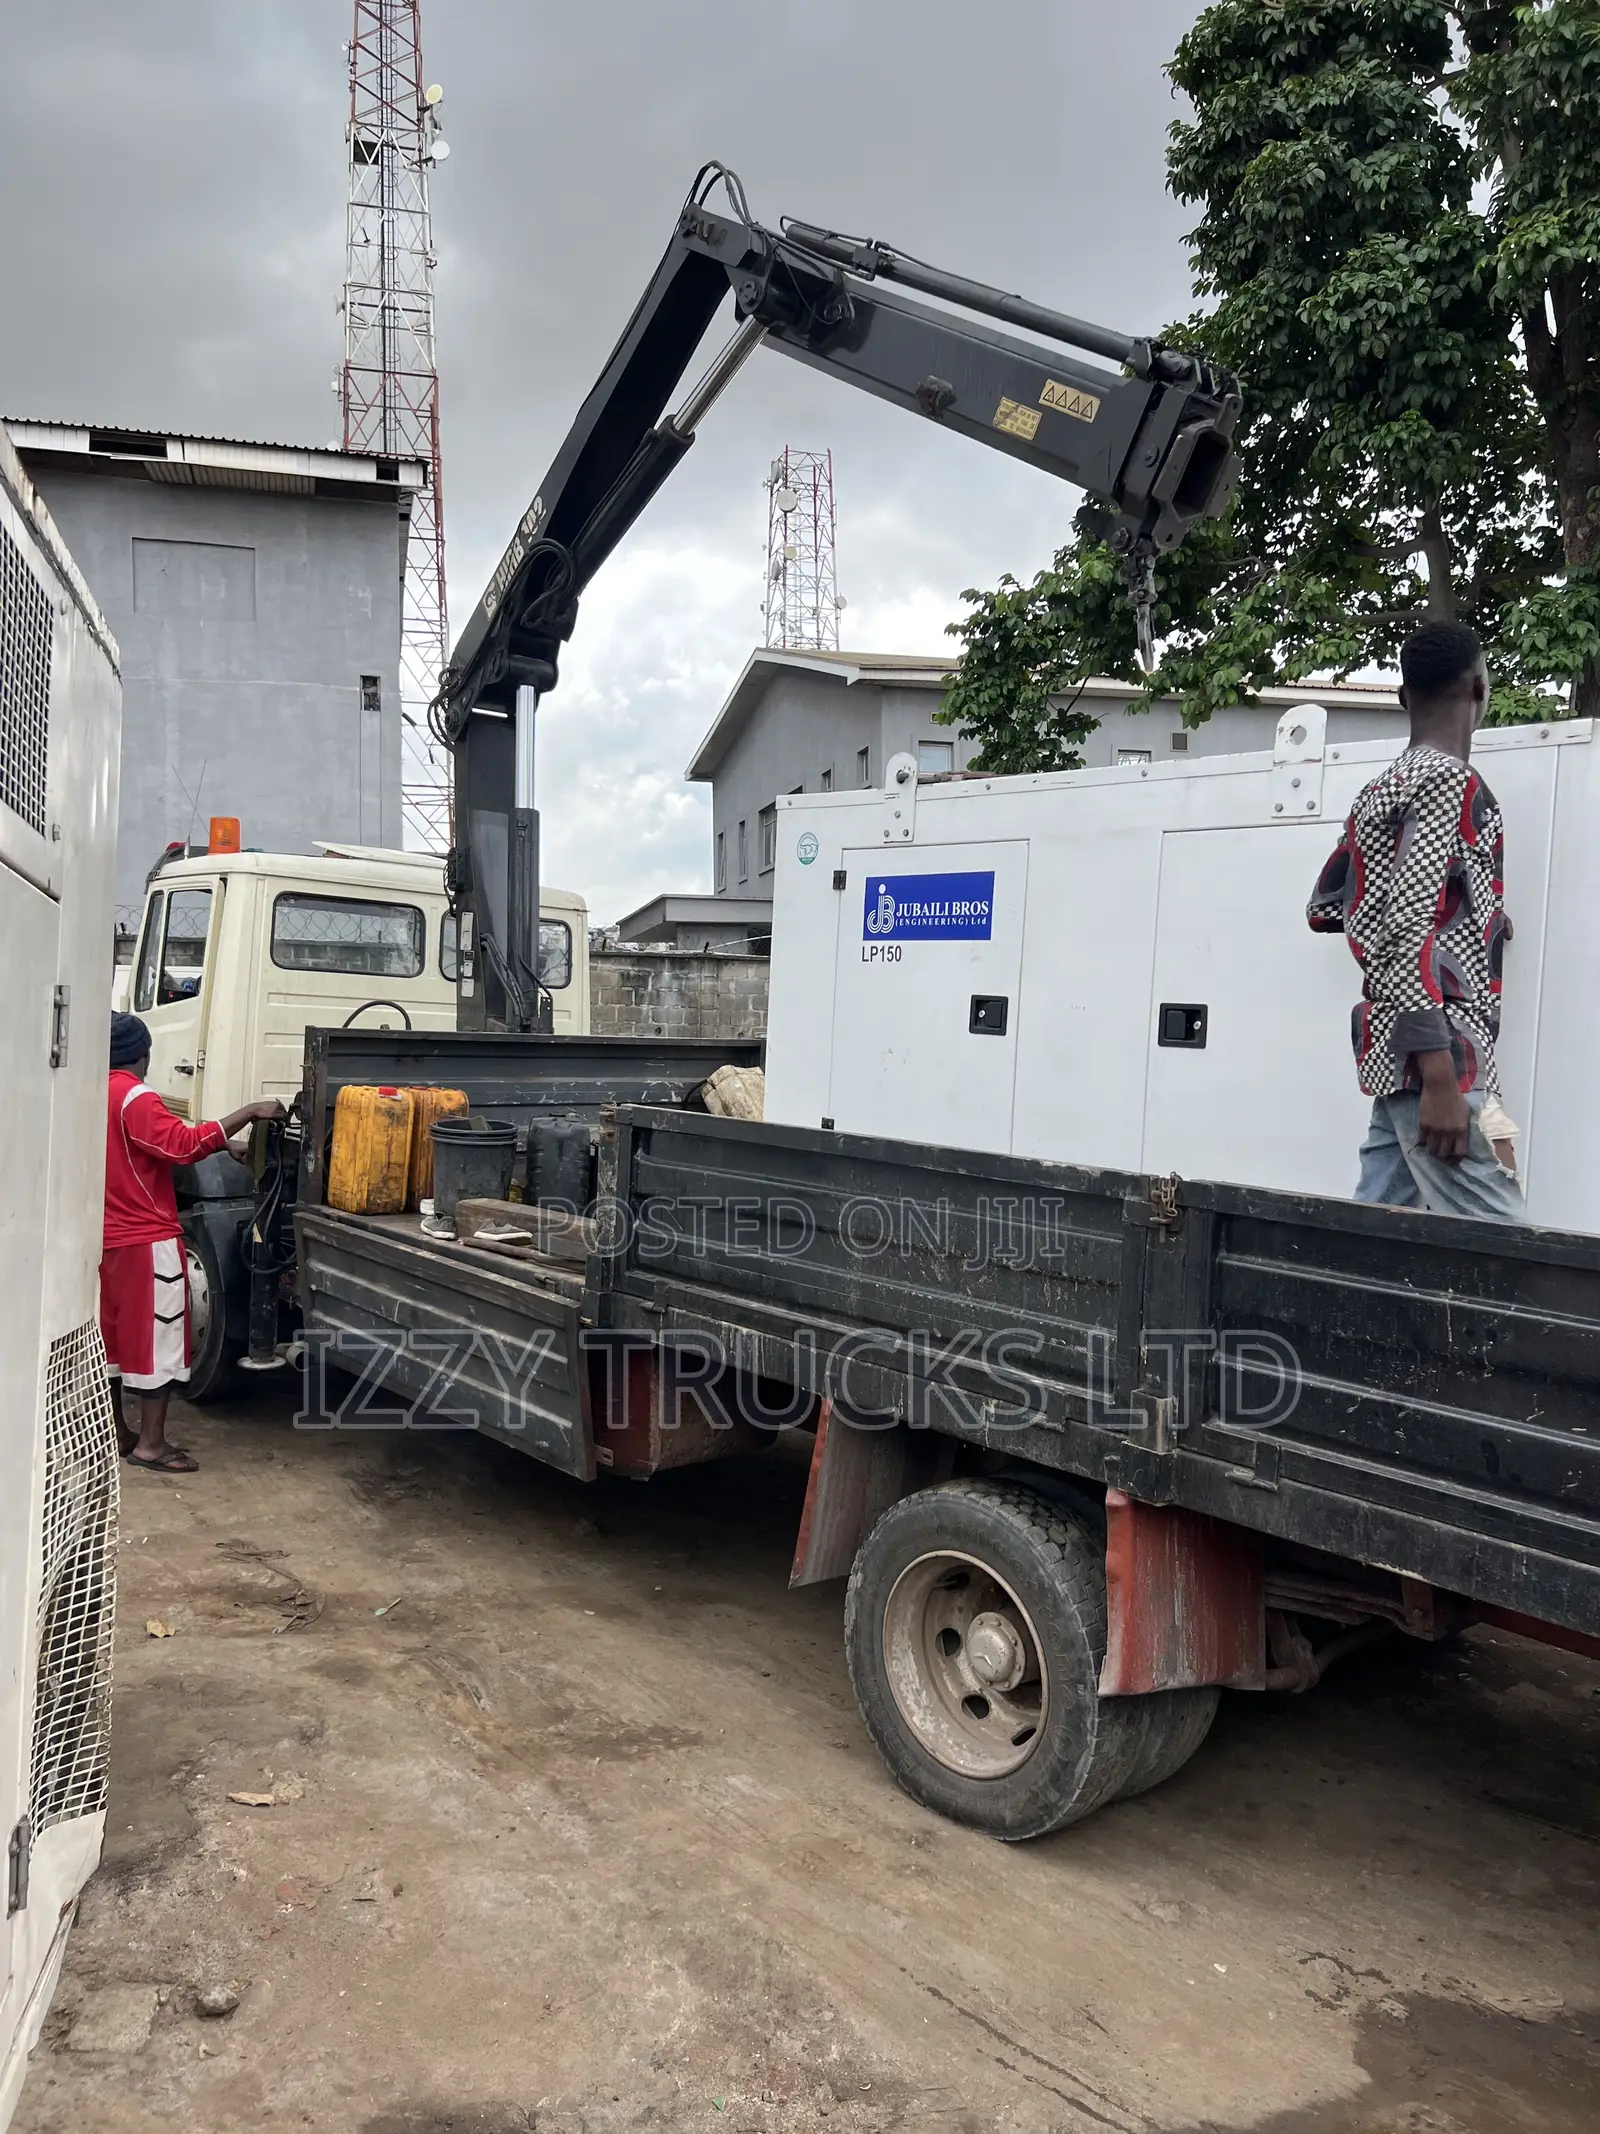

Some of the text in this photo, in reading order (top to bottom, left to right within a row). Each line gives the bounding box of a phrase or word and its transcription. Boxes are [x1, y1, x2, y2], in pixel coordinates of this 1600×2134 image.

[496, 537, 524, 590] HIAB
[896, 900, 989, 917] JUBAILI BROS
[895, 917, 969, 927] (ENGINEERING)
[862, 945, 902, 963] LP150
